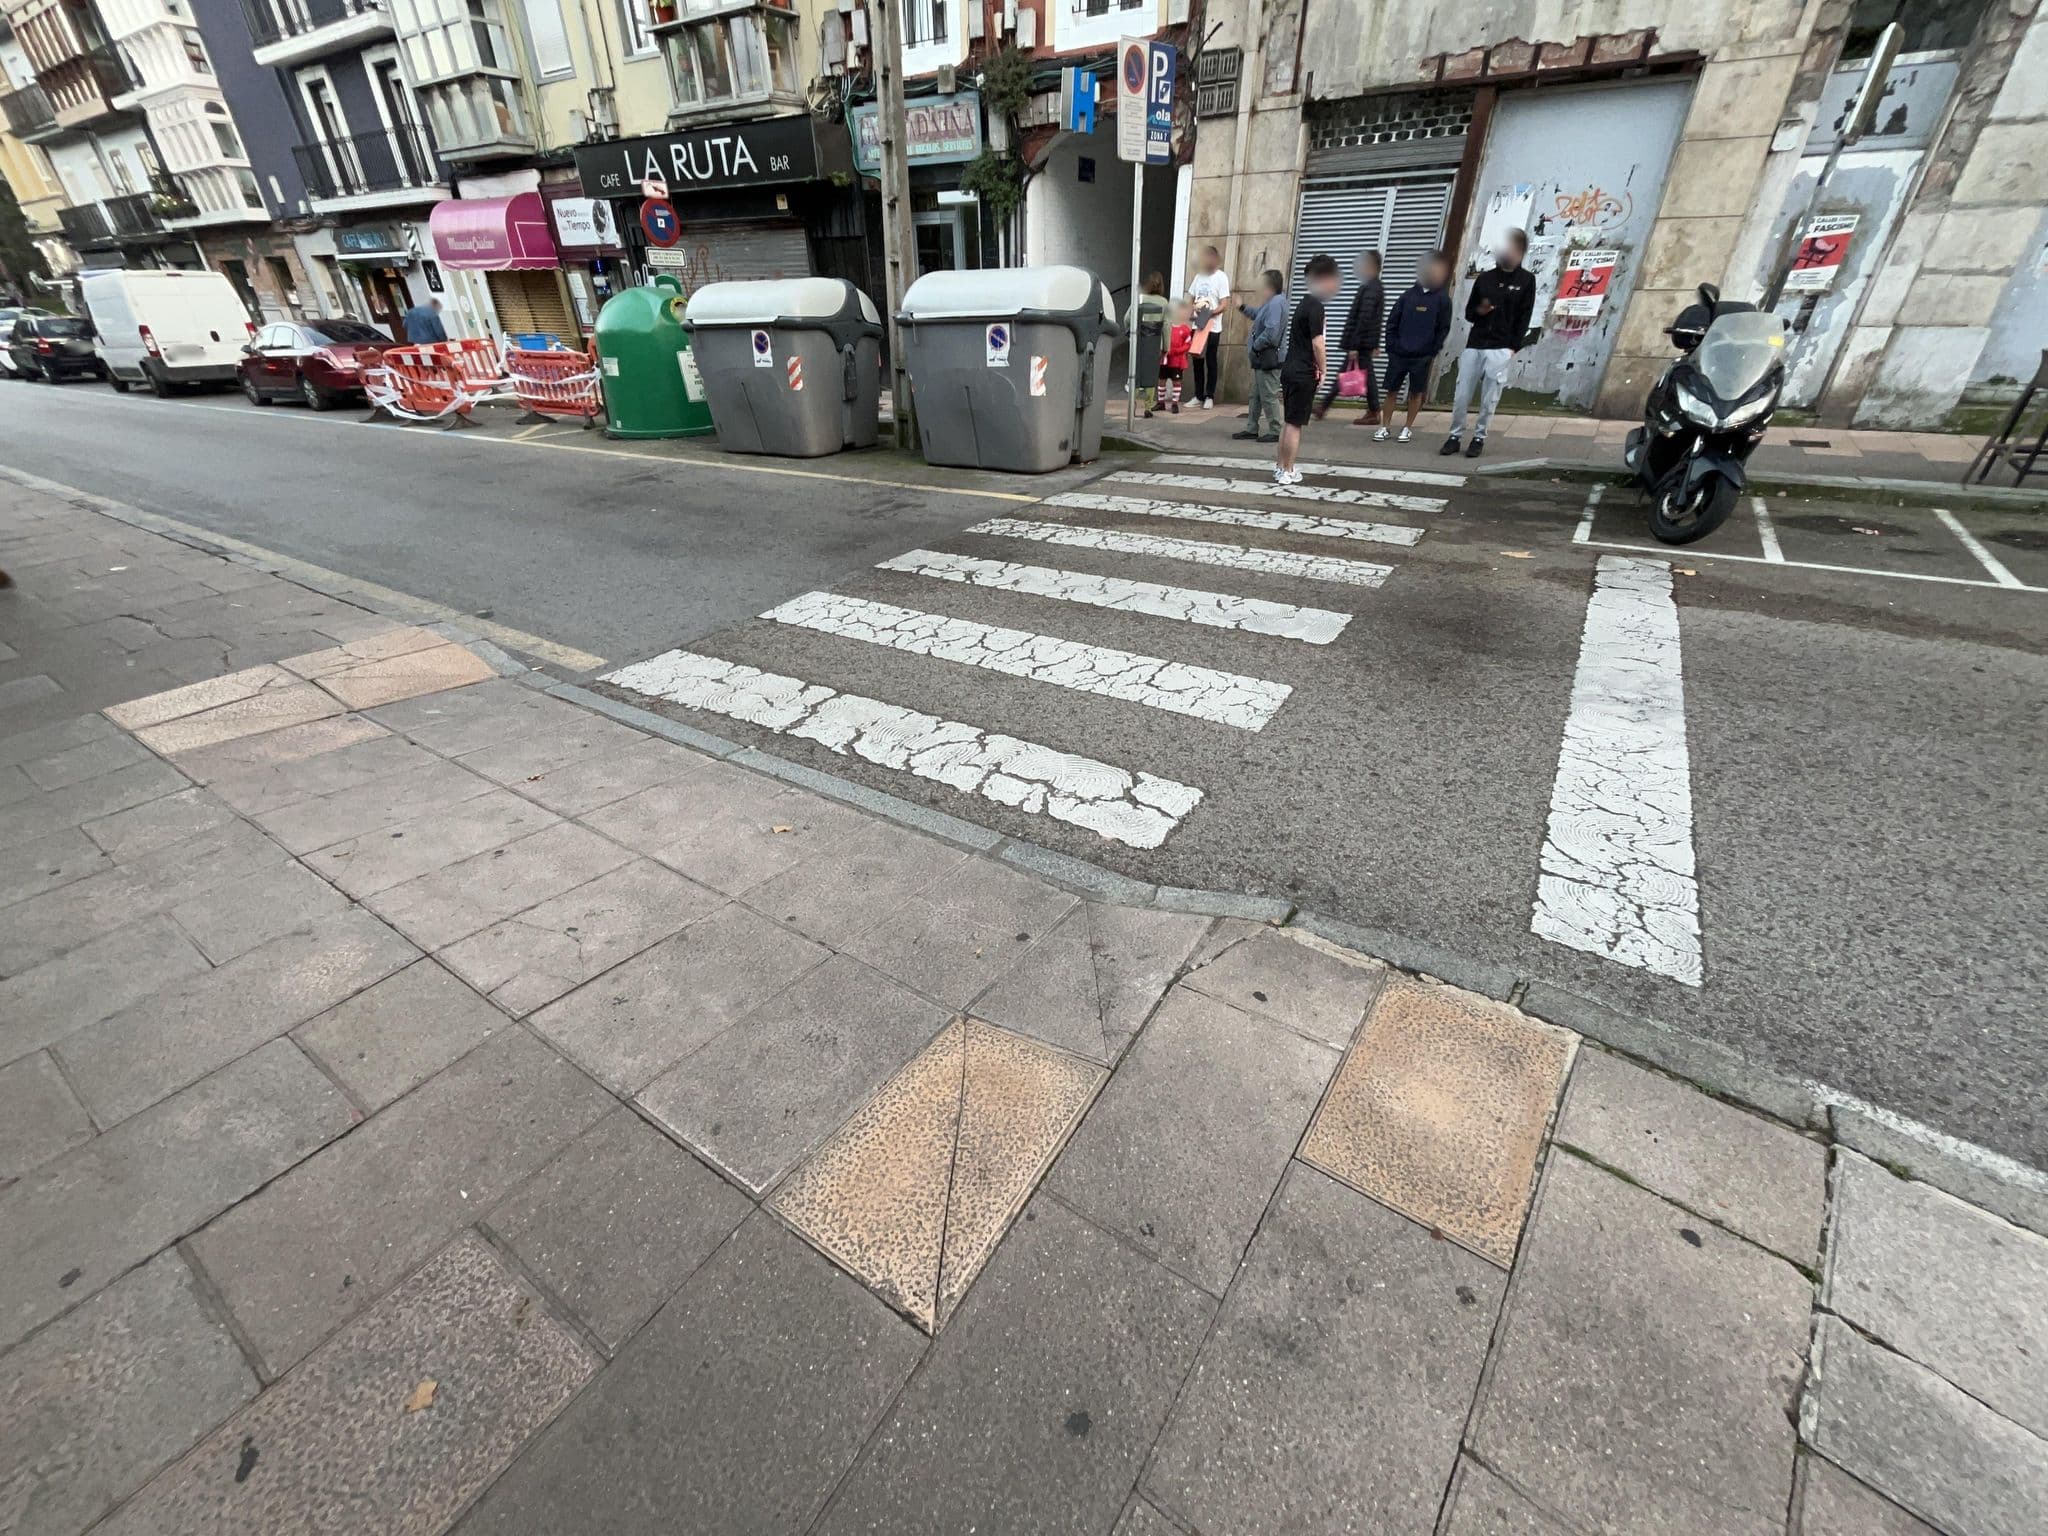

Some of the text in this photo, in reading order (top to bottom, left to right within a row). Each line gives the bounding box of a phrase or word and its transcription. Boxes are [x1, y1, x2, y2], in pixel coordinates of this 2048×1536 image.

[1151, 50, 1169, 104] P
[1156, 108, 1171, 122] ola
[1150, 130, 1163, 141] ZONA
[600, 134, 790, 188] CAFE LA RUTA BAR
[556, 208, 577, 218] Nuevo
[566, 220, 591, 232] Tiempo
[1814, 223, 1854, 232] FASCISMO
[1569, 259, 1581, 267] EL
